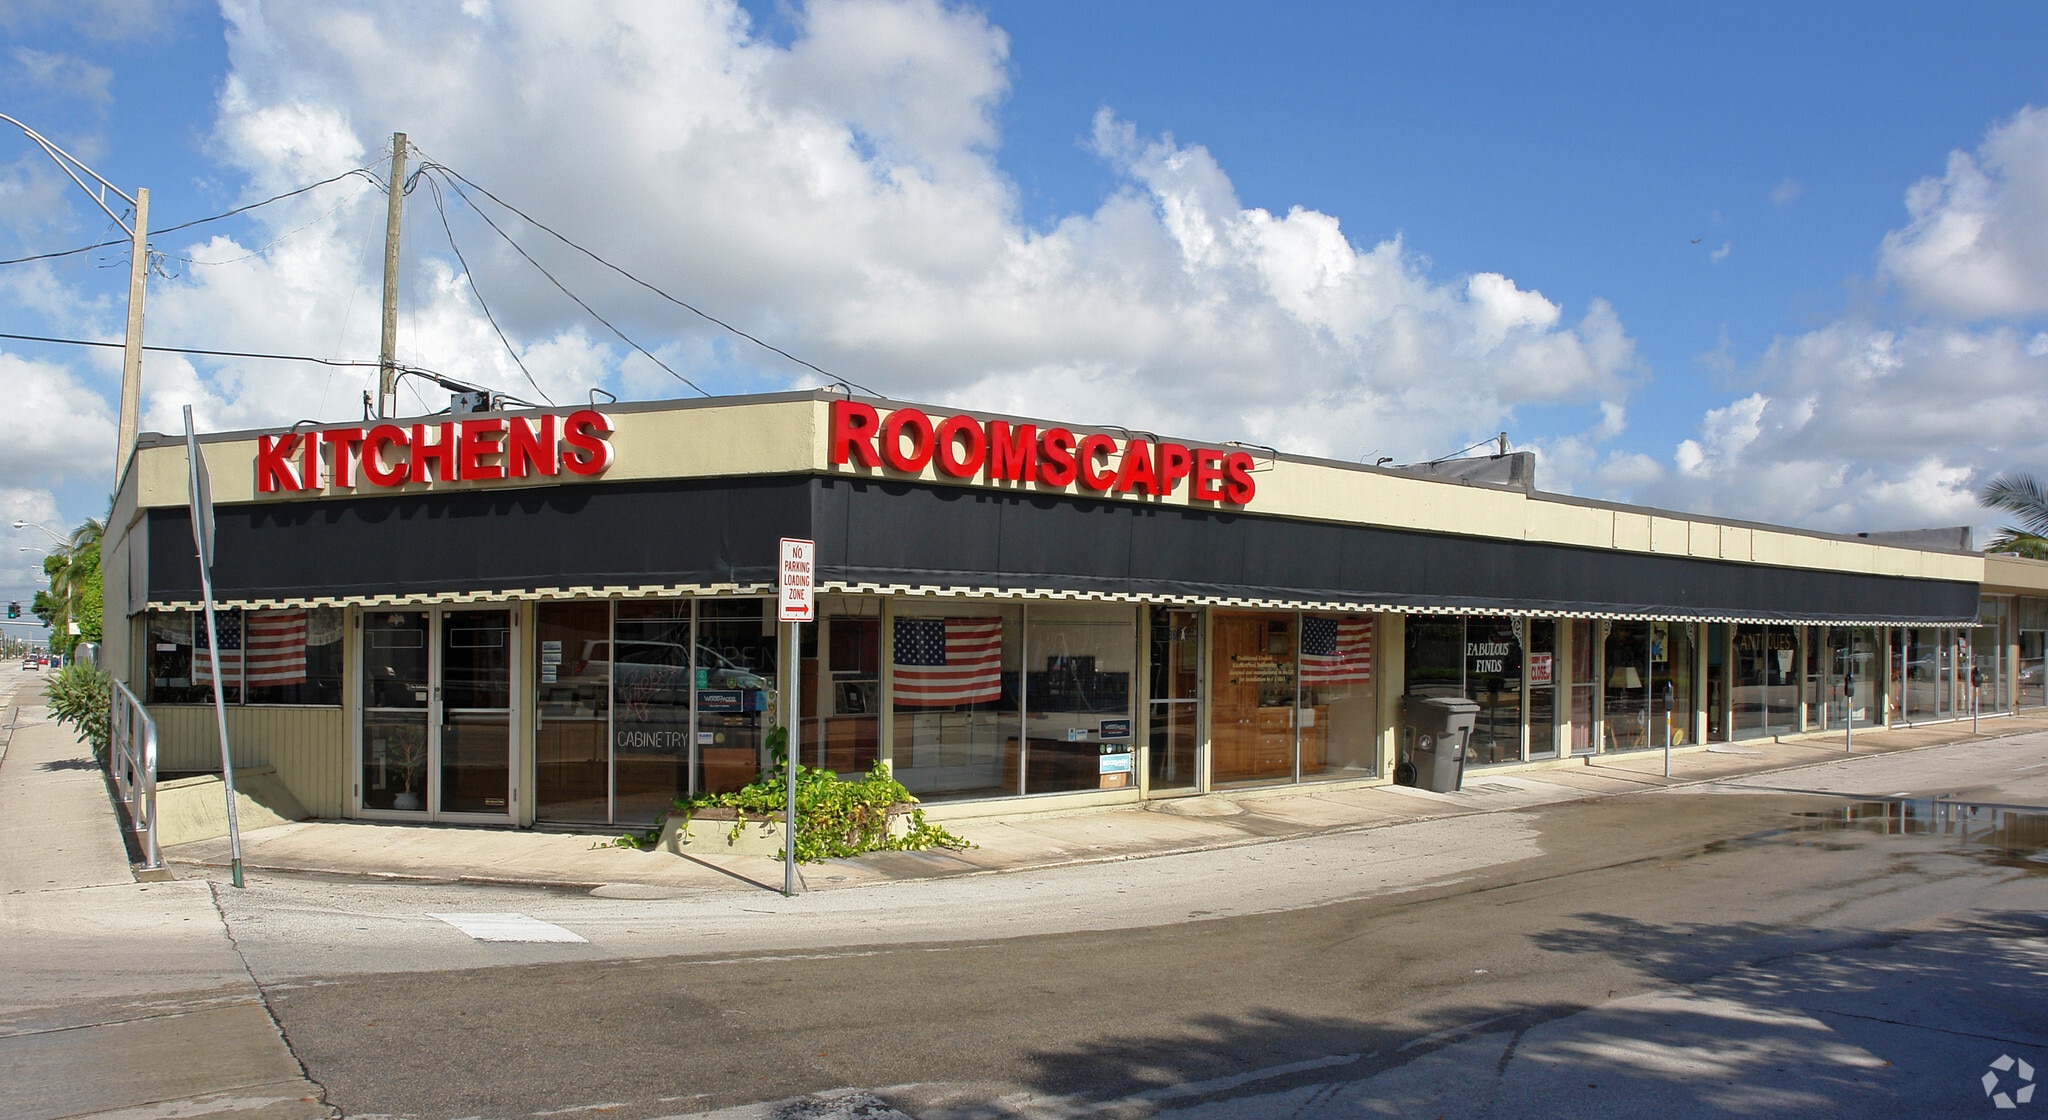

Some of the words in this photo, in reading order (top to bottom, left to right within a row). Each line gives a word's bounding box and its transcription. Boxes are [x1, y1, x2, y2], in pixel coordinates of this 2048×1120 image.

[257, 410, 615, 493] KITCHENS
[829, 399, 1256, 505] ROOMSCAPES
[792, 547, 803, 559] NO
[784, 560, 810, 573] PARKING
[784, 575, 810, 587] LOADING
[789, 588, 805, 600] ZONE
[1466, 642, 1510, 656] FABULOUS
[1475, 659, 1503, 673] FINDS
[617, 731, 688, 748] CABINETRY
